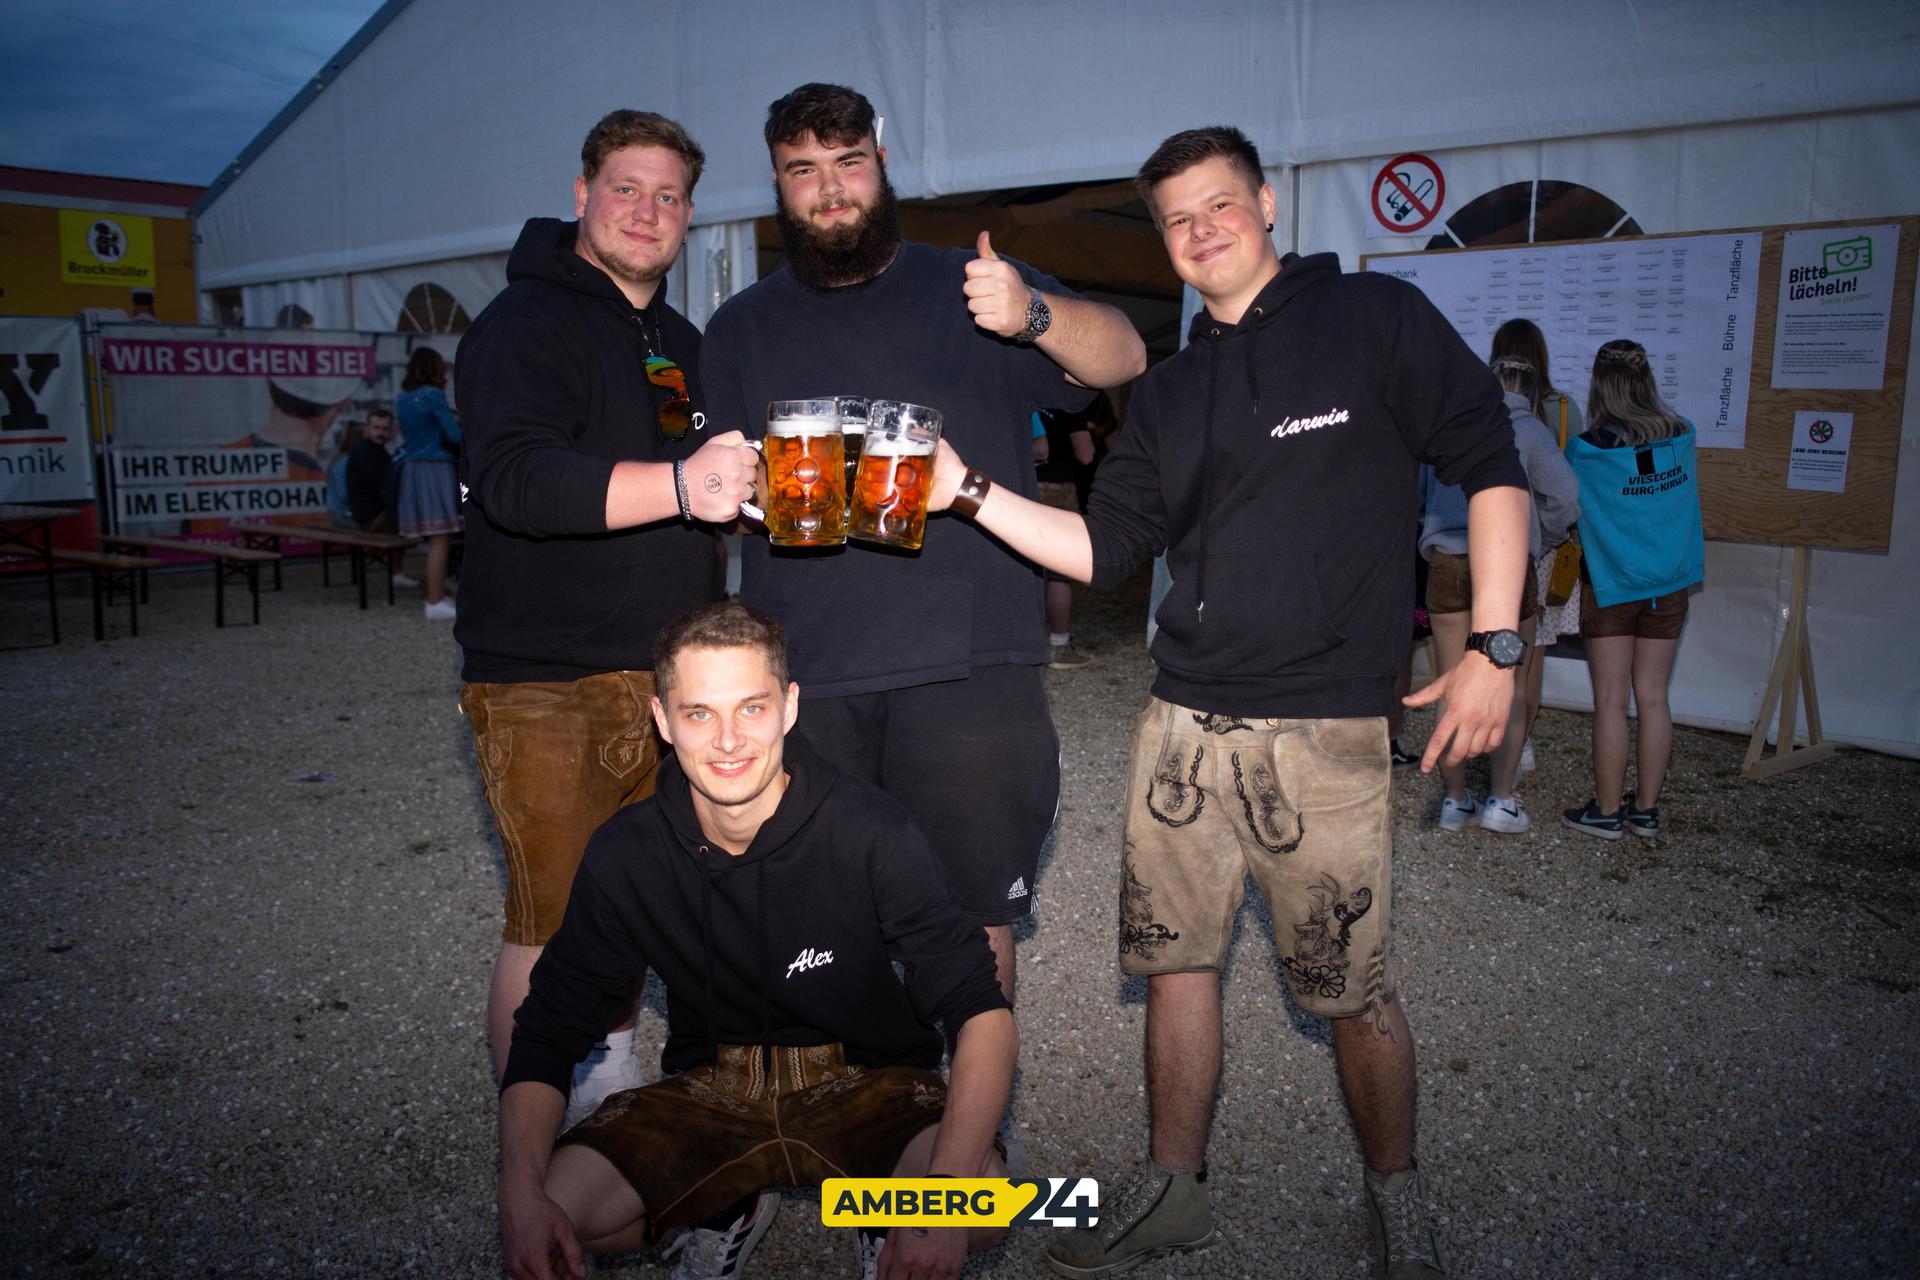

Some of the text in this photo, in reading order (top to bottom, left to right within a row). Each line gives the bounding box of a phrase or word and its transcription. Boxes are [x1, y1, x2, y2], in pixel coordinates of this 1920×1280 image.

[1727, 239, 1744, 301] Tanzfläche
[1789, 266, 1828, 283] Bitte
[1790, 277, 1858, 301] lächeln!
[1723, 313, 1737, 352] Bühne
[109, 345, 368, 375] WIR SUCHEN SIE!
[1716, 367, 1734, 428] Tanzfläche
[122, 453, 284, 478] IHR TRUMPF
[1629, 465, 1683, 485] VILSECKER
[1622, 472, 1689, 496] BURG-KIRWA
[125, 494, 157, 516] IM
[785, 947, 835, 979] Alex
